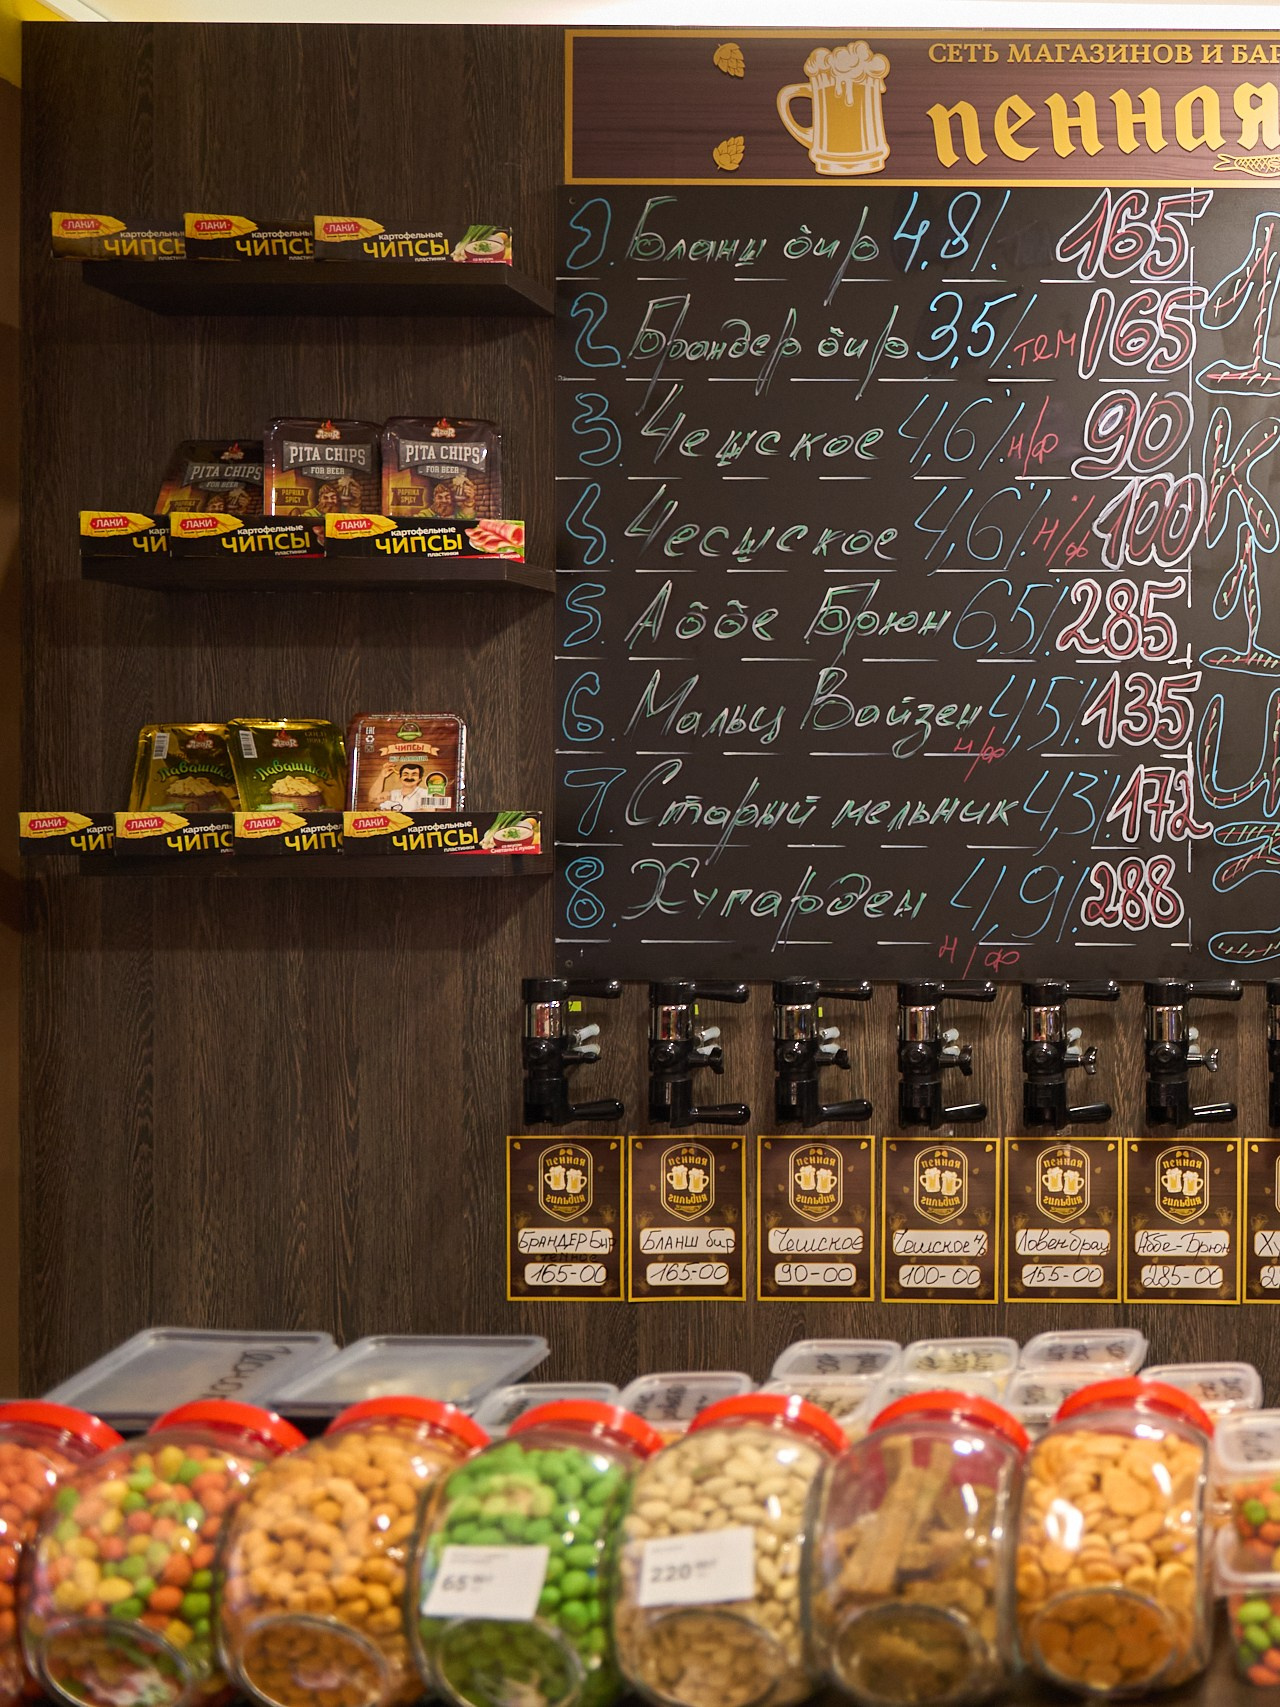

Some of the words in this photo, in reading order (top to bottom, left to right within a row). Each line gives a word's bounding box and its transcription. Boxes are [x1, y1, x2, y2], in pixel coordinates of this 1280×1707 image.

[928, 44, 999, 63] СЕТЬ
[1007, 44, 1193, 64] МАГАЗИНОВ
[1200, 45, 1224, 64] И
[329, 224, 356, 233] ЛАКИ
[1056, 188, 1213, 280] 165
[363, 239, 449, 259] ЧИПСЫ
[1078, 286, 1209, 379] 165
[1071, 388, 1194, 479] 90
[405, 445, 436, 463] PITA
[440, 444, 481, 464] CHIPS
[340, 520, 367, 530] ЛАКИ
[391, 526, 456, 537] картофельные
[1092, 472, 1207, 570] 100
[221, 531, 311, 553] ЧИПСЫ
[375, 533, 463, 555] ЧИПСЫ
[1056, 576, 1185, 661] 285
[1081, 671, 1202, 750] 135
[357, 817, 385, 828] ЛАКИ
[391, 827, 479, 850] ЧИПСЫ
[1081, 854, 1184, 931] 288
